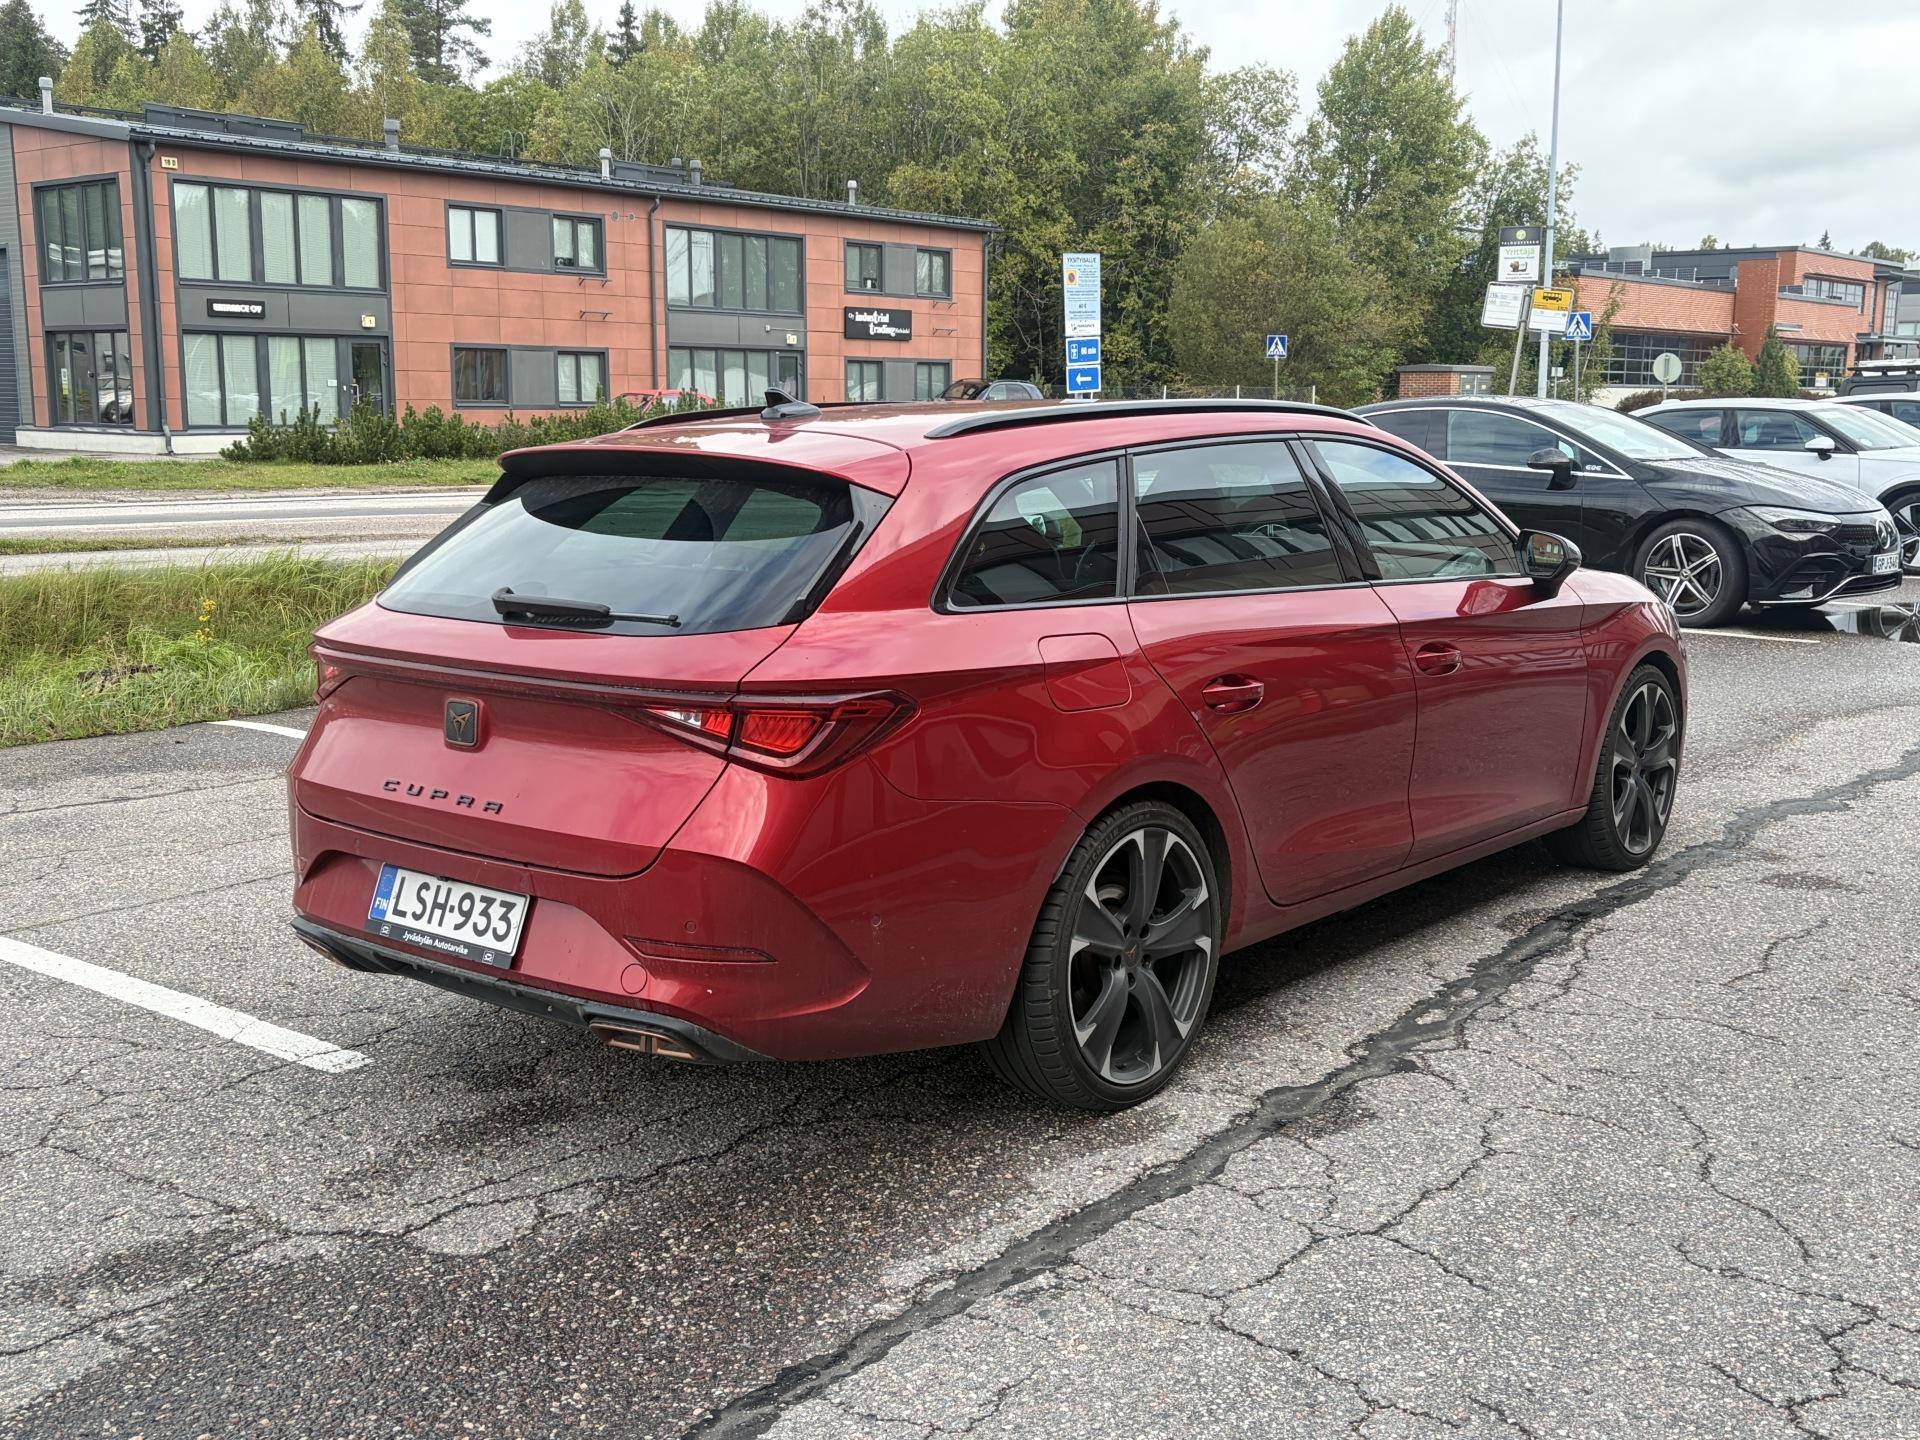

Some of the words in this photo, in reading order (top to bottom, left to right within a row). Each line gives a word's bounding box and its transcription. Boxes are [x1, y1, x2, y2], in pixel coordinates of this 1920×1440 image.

[855, 310, 890, 324] industrial
[869, 322, 896, 337] trading
[383, 779, 504, 815] CUPRA
[374, 897, 389, 911] FIN
[392, 876, 517, 942] LSH-933
[402, 930, 434, 947] Jyväskylän
[433, 938, 469, 956] Autotarvike
